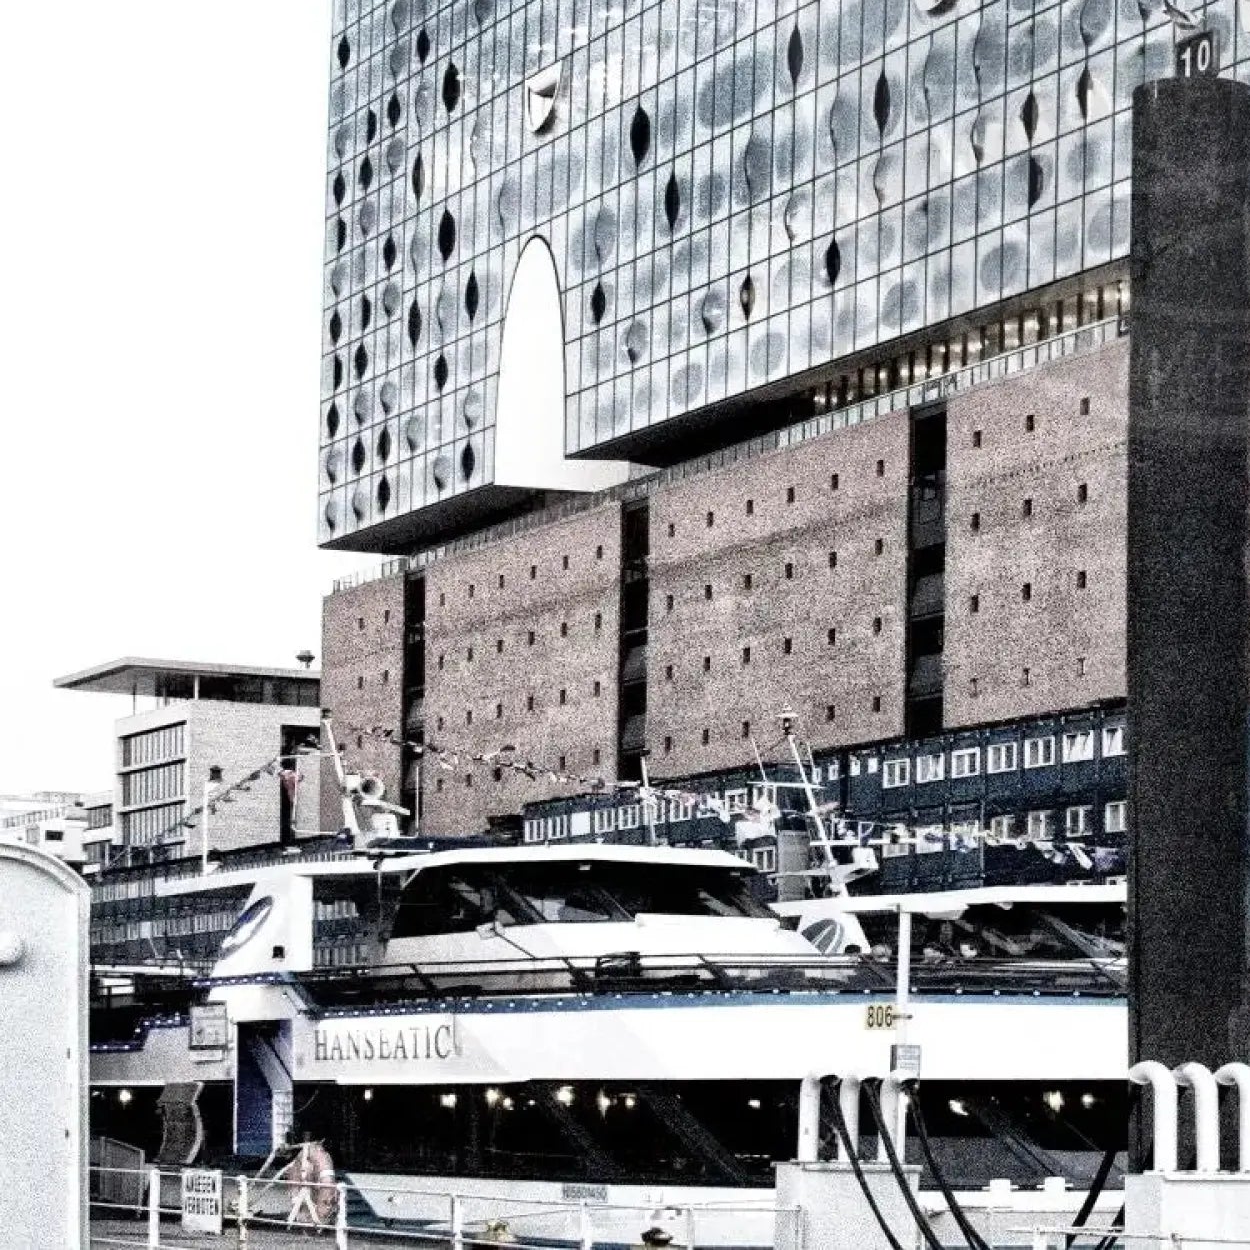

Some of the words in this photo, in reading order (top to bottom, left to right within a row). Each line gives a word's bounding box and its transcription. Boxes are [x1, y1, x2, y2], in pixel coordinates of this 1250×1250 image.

[1180, 40, 1210, 77] 10
[867, 1005, 893, 1028] 806
[314, 1024, 452, 1061] HANSEATIC
